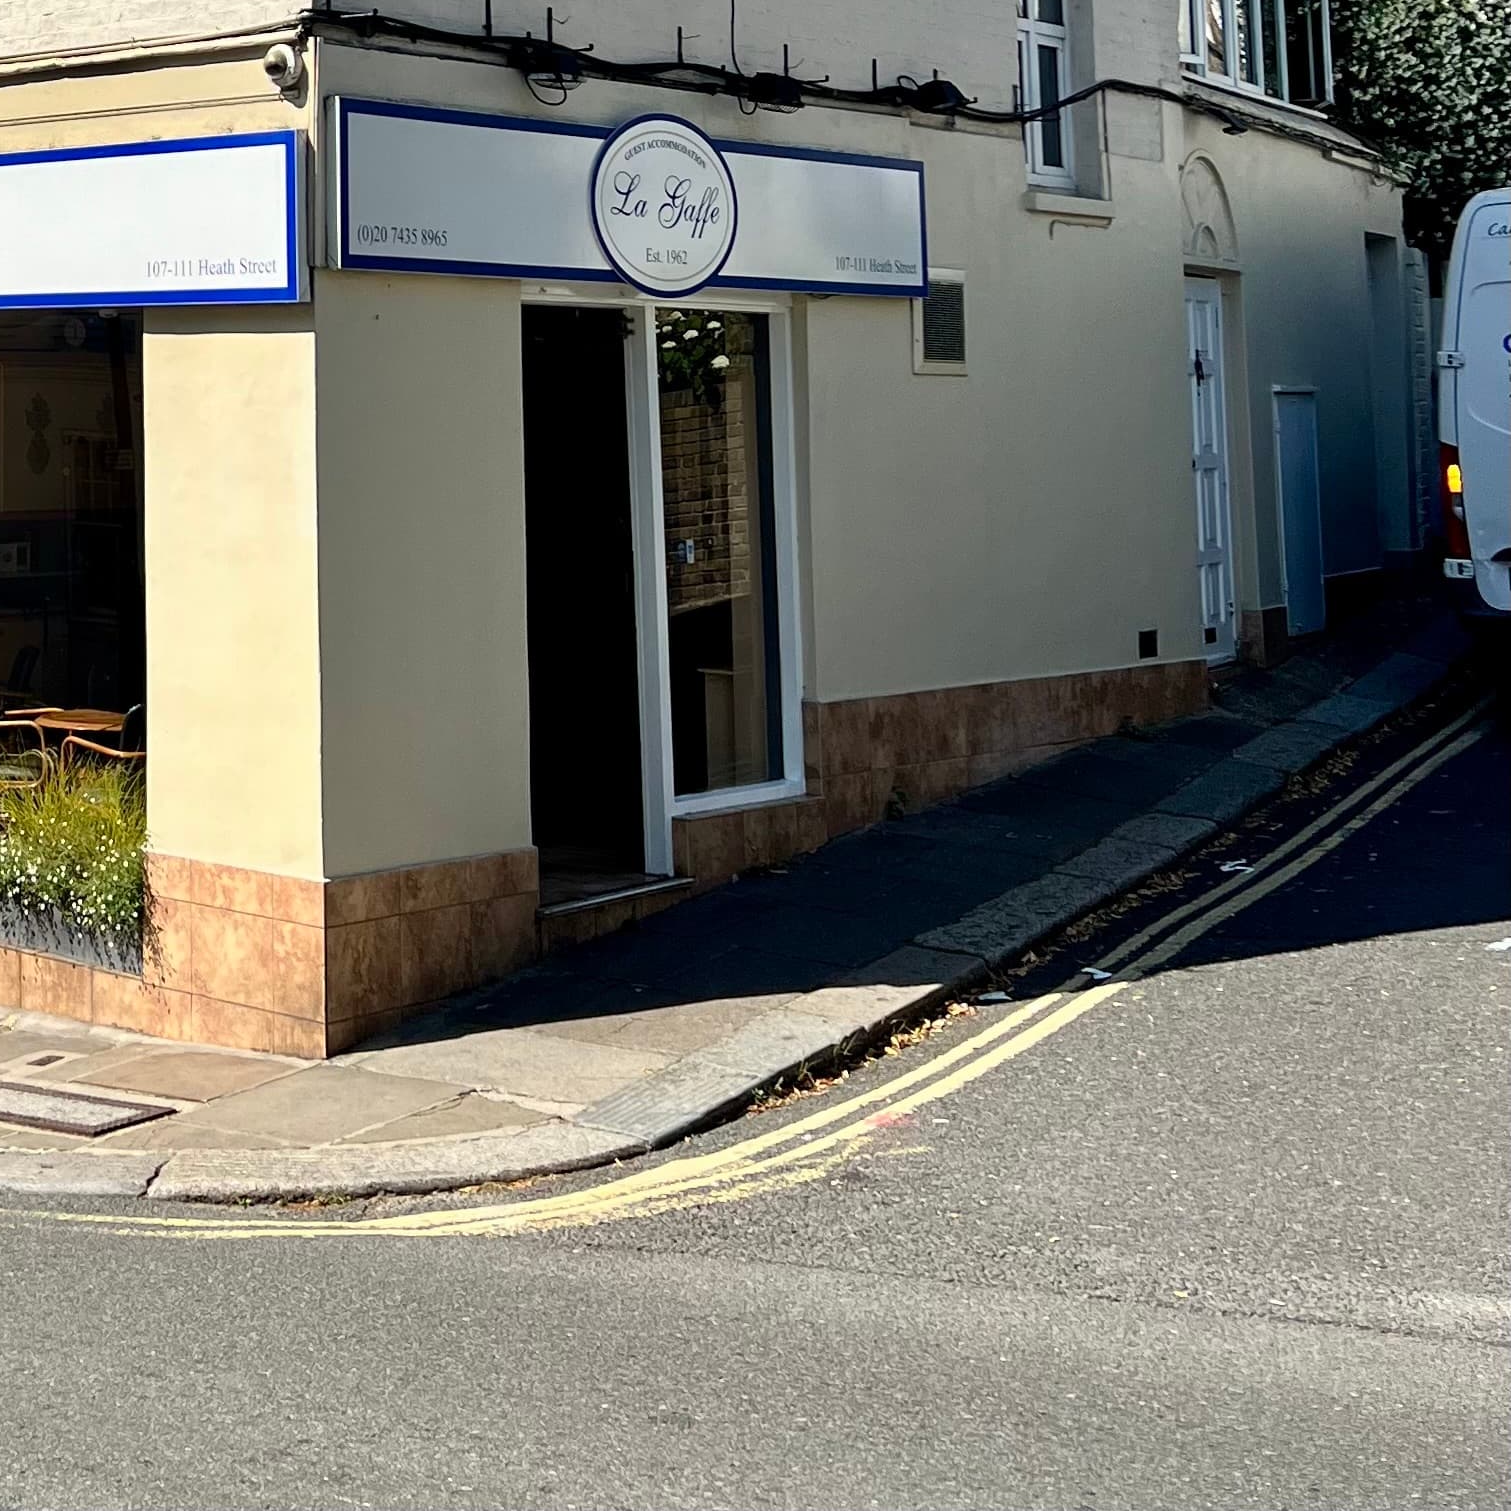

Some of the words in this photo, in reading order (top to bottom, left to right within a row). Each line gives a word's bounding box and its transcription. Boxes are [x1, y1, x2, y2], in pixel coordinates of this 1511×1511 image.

[624, 142, 646, 160] GUEST
[610, 171, 647, 217] La
[658, 175, 720, 239] Gaffe
[357, 224, 388, 246] (0)20
[391, 226, 418, 245] 7435
[421, 229, 448, 247] 8965
[646, 248, 663, 264] Est.
[666, 250, 688, 265] 1962
[146, 259, 193, 278] 107-111
[198, 258, 235, 276] Heath
[239, 257, 277, 275] Street
